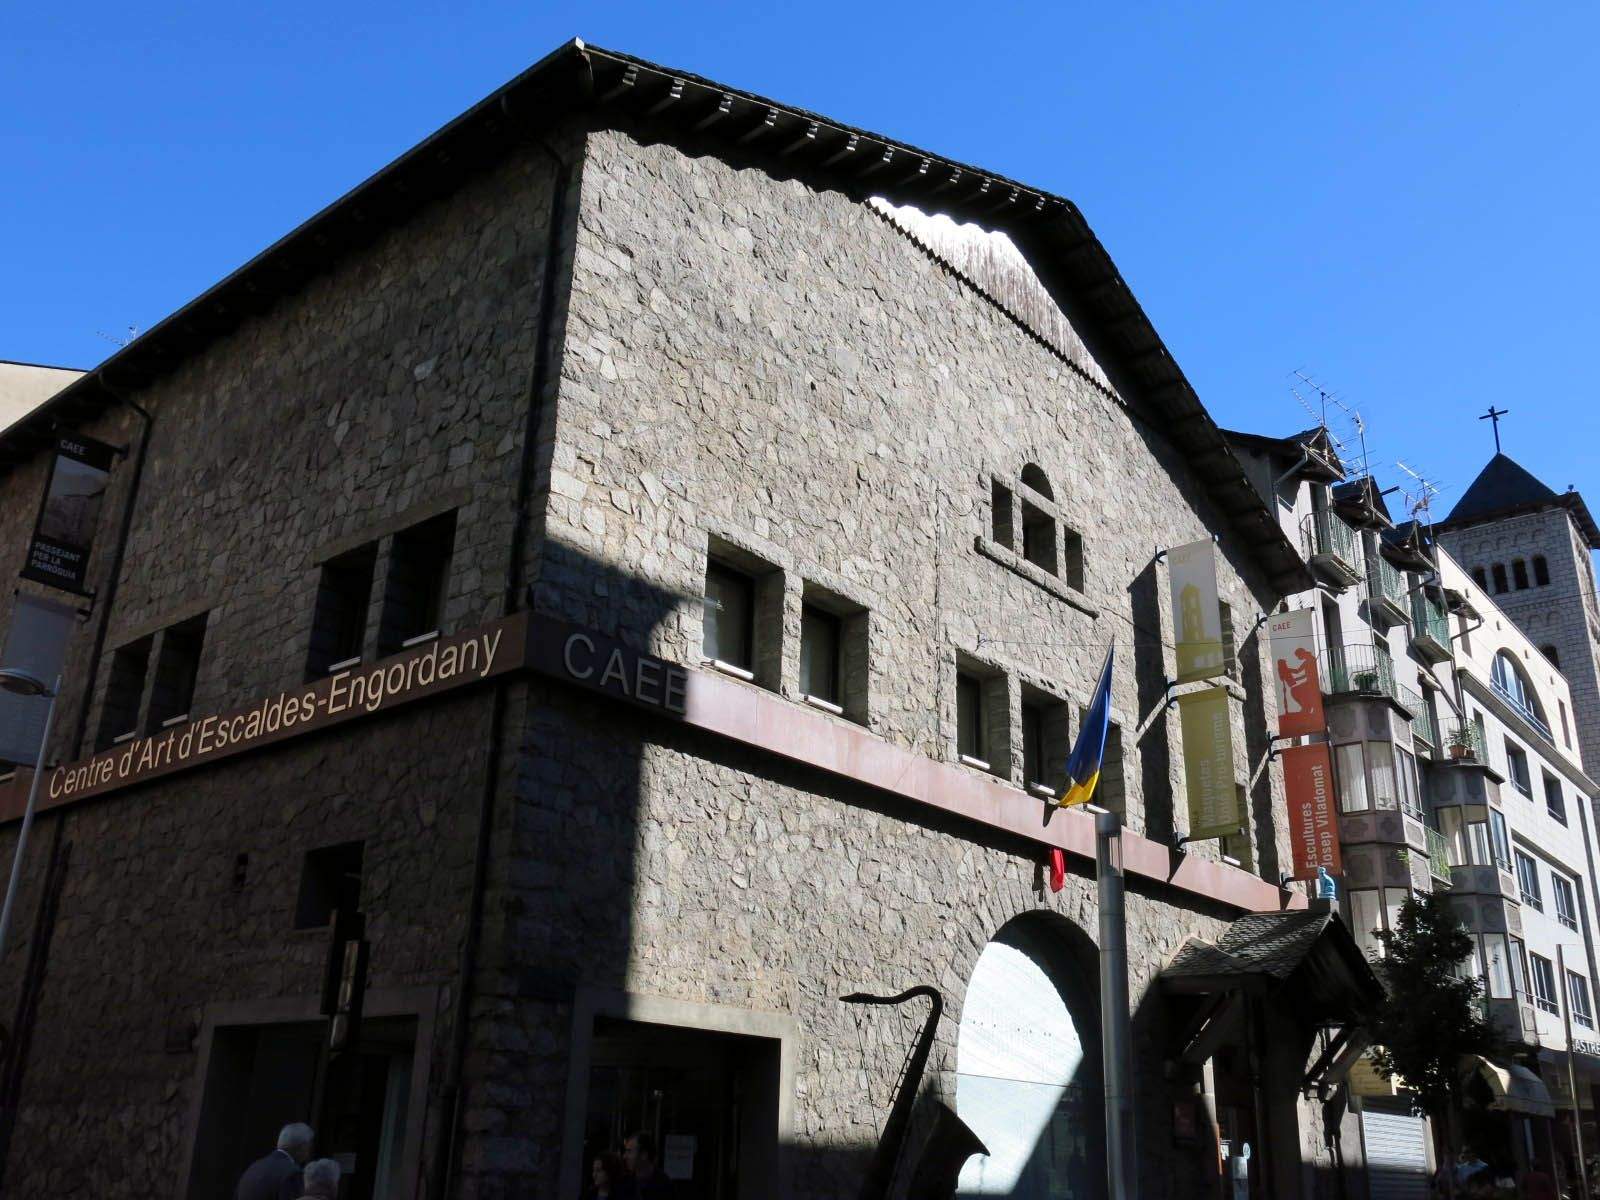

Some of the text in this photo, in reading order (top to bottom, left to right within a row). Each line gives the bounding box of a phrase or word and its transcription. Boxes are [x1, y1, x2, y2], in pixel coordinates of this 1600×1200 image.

[33, 550, 61, 565] PER LA
[1272, 621, 1292, 632] CAEE
[564, 633, 688, 717] CAEE
[50, 629, 502, 798] Centre d'Art d'Escaldes-Engordany
[1302, 802, 1318, 868] Escultures
[1311, 764, 1334, 866] Josep Viladomat
